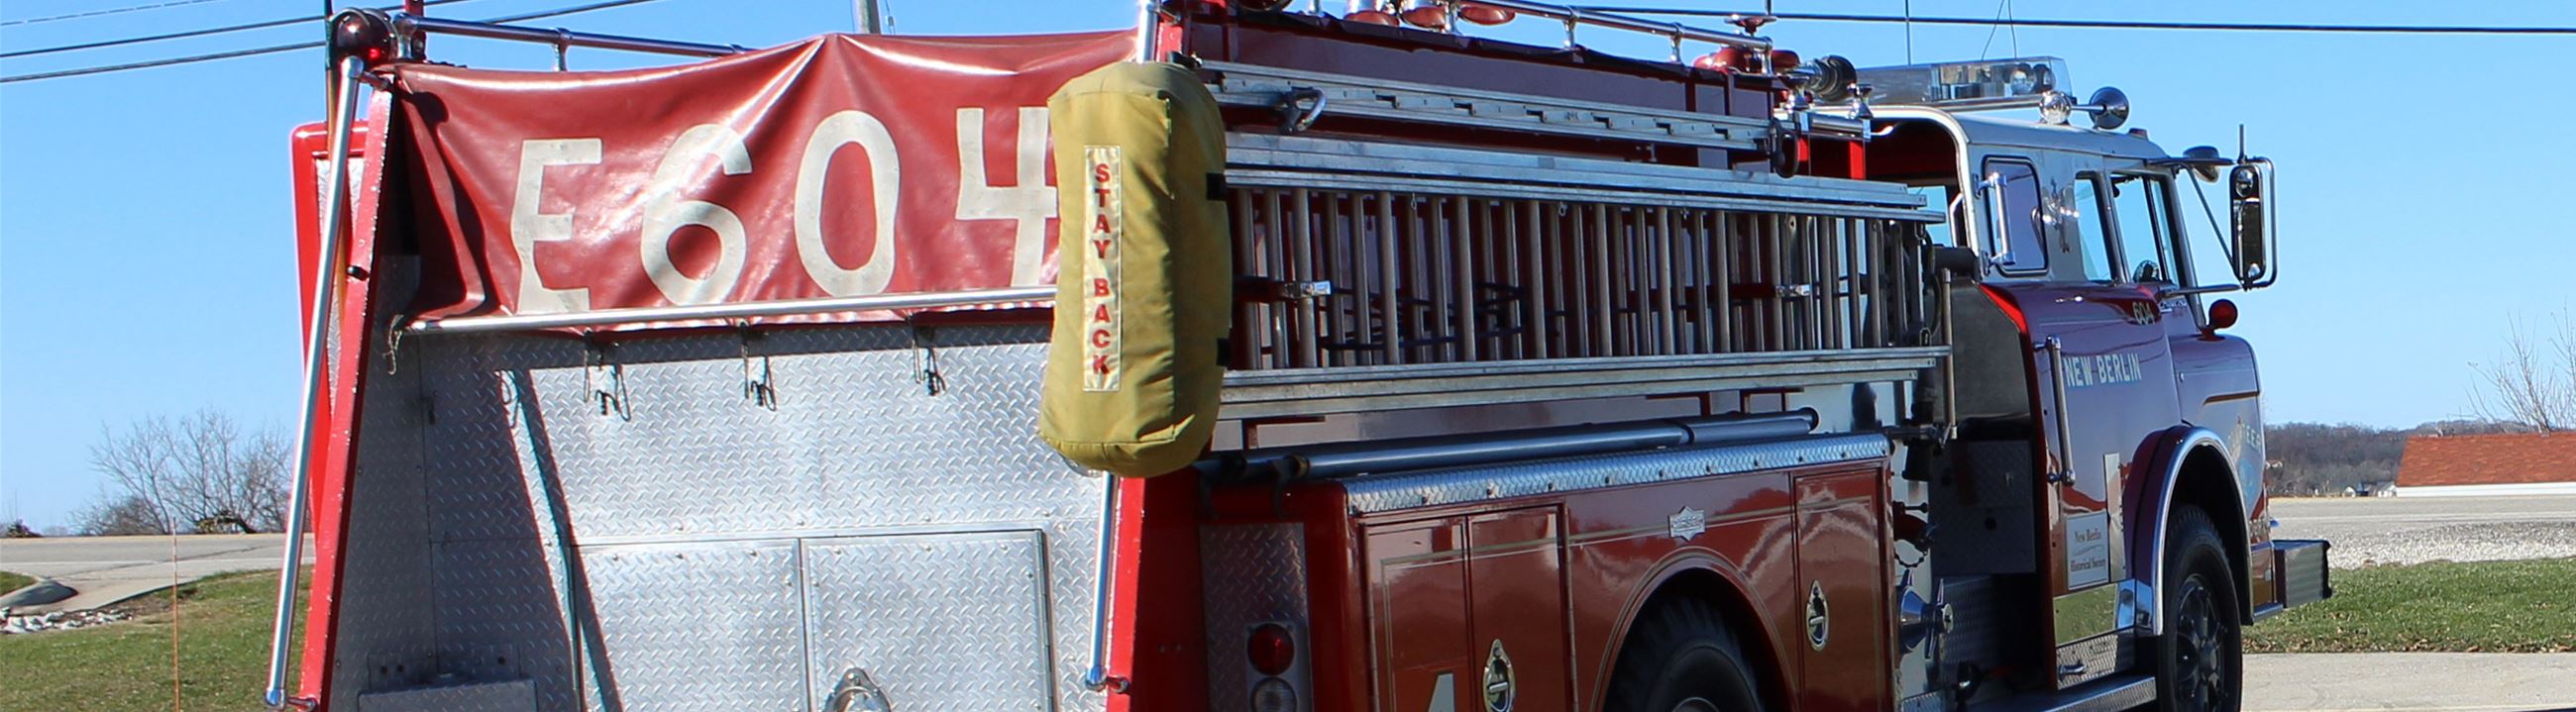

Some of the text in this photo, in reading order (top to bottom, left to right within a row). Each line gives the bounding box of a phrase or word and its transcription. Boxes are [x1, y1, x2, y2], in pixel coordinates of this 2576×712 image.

[1092, 163, 1112, 375] STAY BACK
[2132, 301, 2156, 326] 604
[2063, 353, 2142, 387] NEW BERLIN
